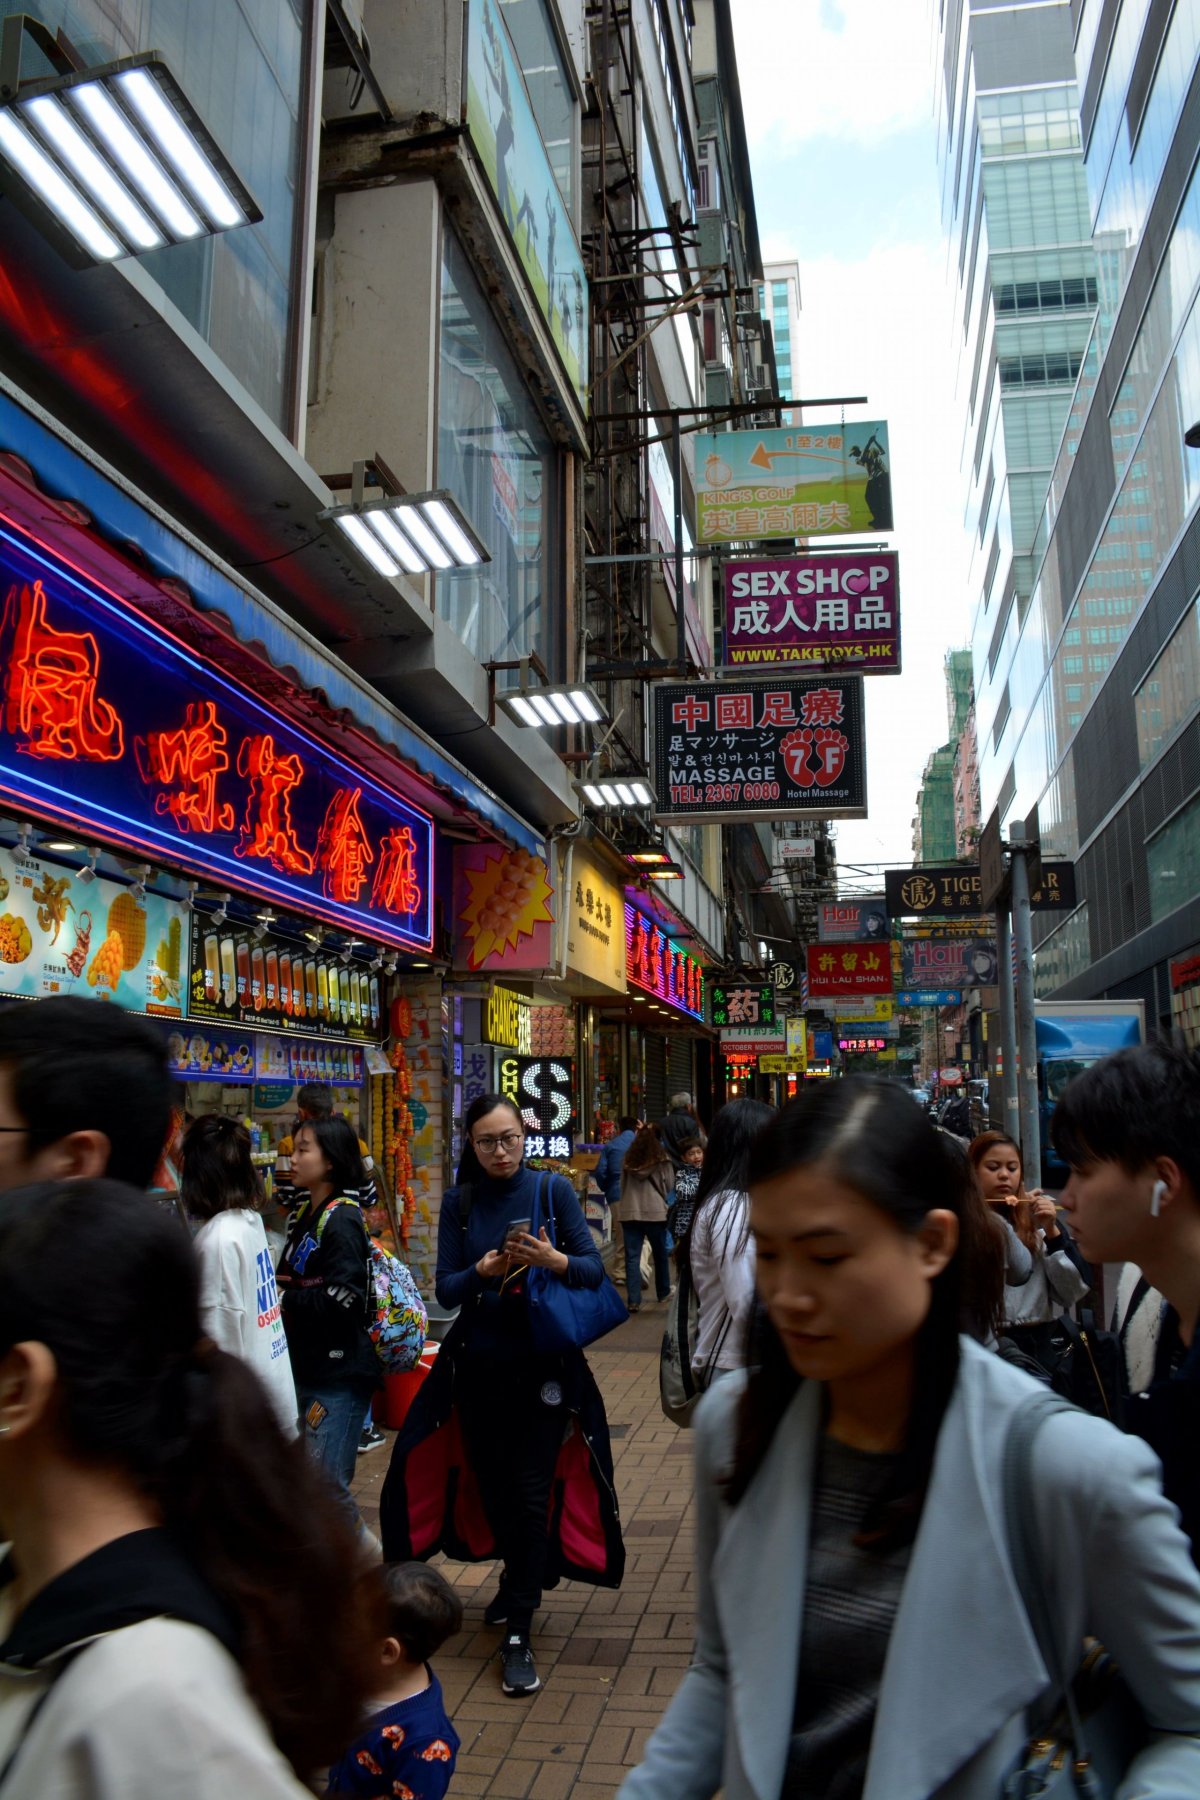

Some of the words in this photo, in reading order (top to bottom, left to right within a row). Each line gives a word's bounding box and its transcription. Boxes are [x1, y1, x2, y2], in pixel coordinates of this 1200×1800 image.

[704, 489, 752, 505] KING'S
[756, 487, 795, 501] GOLF
[703, 500, 850, 538] 英皇高爾夫
[731, 570, 791, 598] SEX
[797, 566, 889, 596] SHOP
[731, 596, 892, 635] 成人用品
[731, 644, 893, 663] WWW.TAKETOYS.HK
[672, 688, 845, 733] 中國足療
[668, 753, 681, 767] 발
[685, 755, 697, 767] &
[790, 749, 804, 775] 7
[825, 747, 840, 774] F
[669, 766, 775, 784] MASSAGE
[669, 785, 703, 803] TEL:
[706, 784, 741, 803] 2367
[743, 782, 780, 801] 6080
[787, 789, 810, 798] Hotel
[811, 788, 849, 798] Massage
[823, 905, 861, 922] Hair
[817, 951, 881, 972] 許留山
[913, 941, 966, 966] Hair
[811, 976, 829, 985] HUI
[832, 976, 852, 984] LAU
[488, 996, 519, 1047] CHANGE
[525, 1137, 570, 1158] 找換
